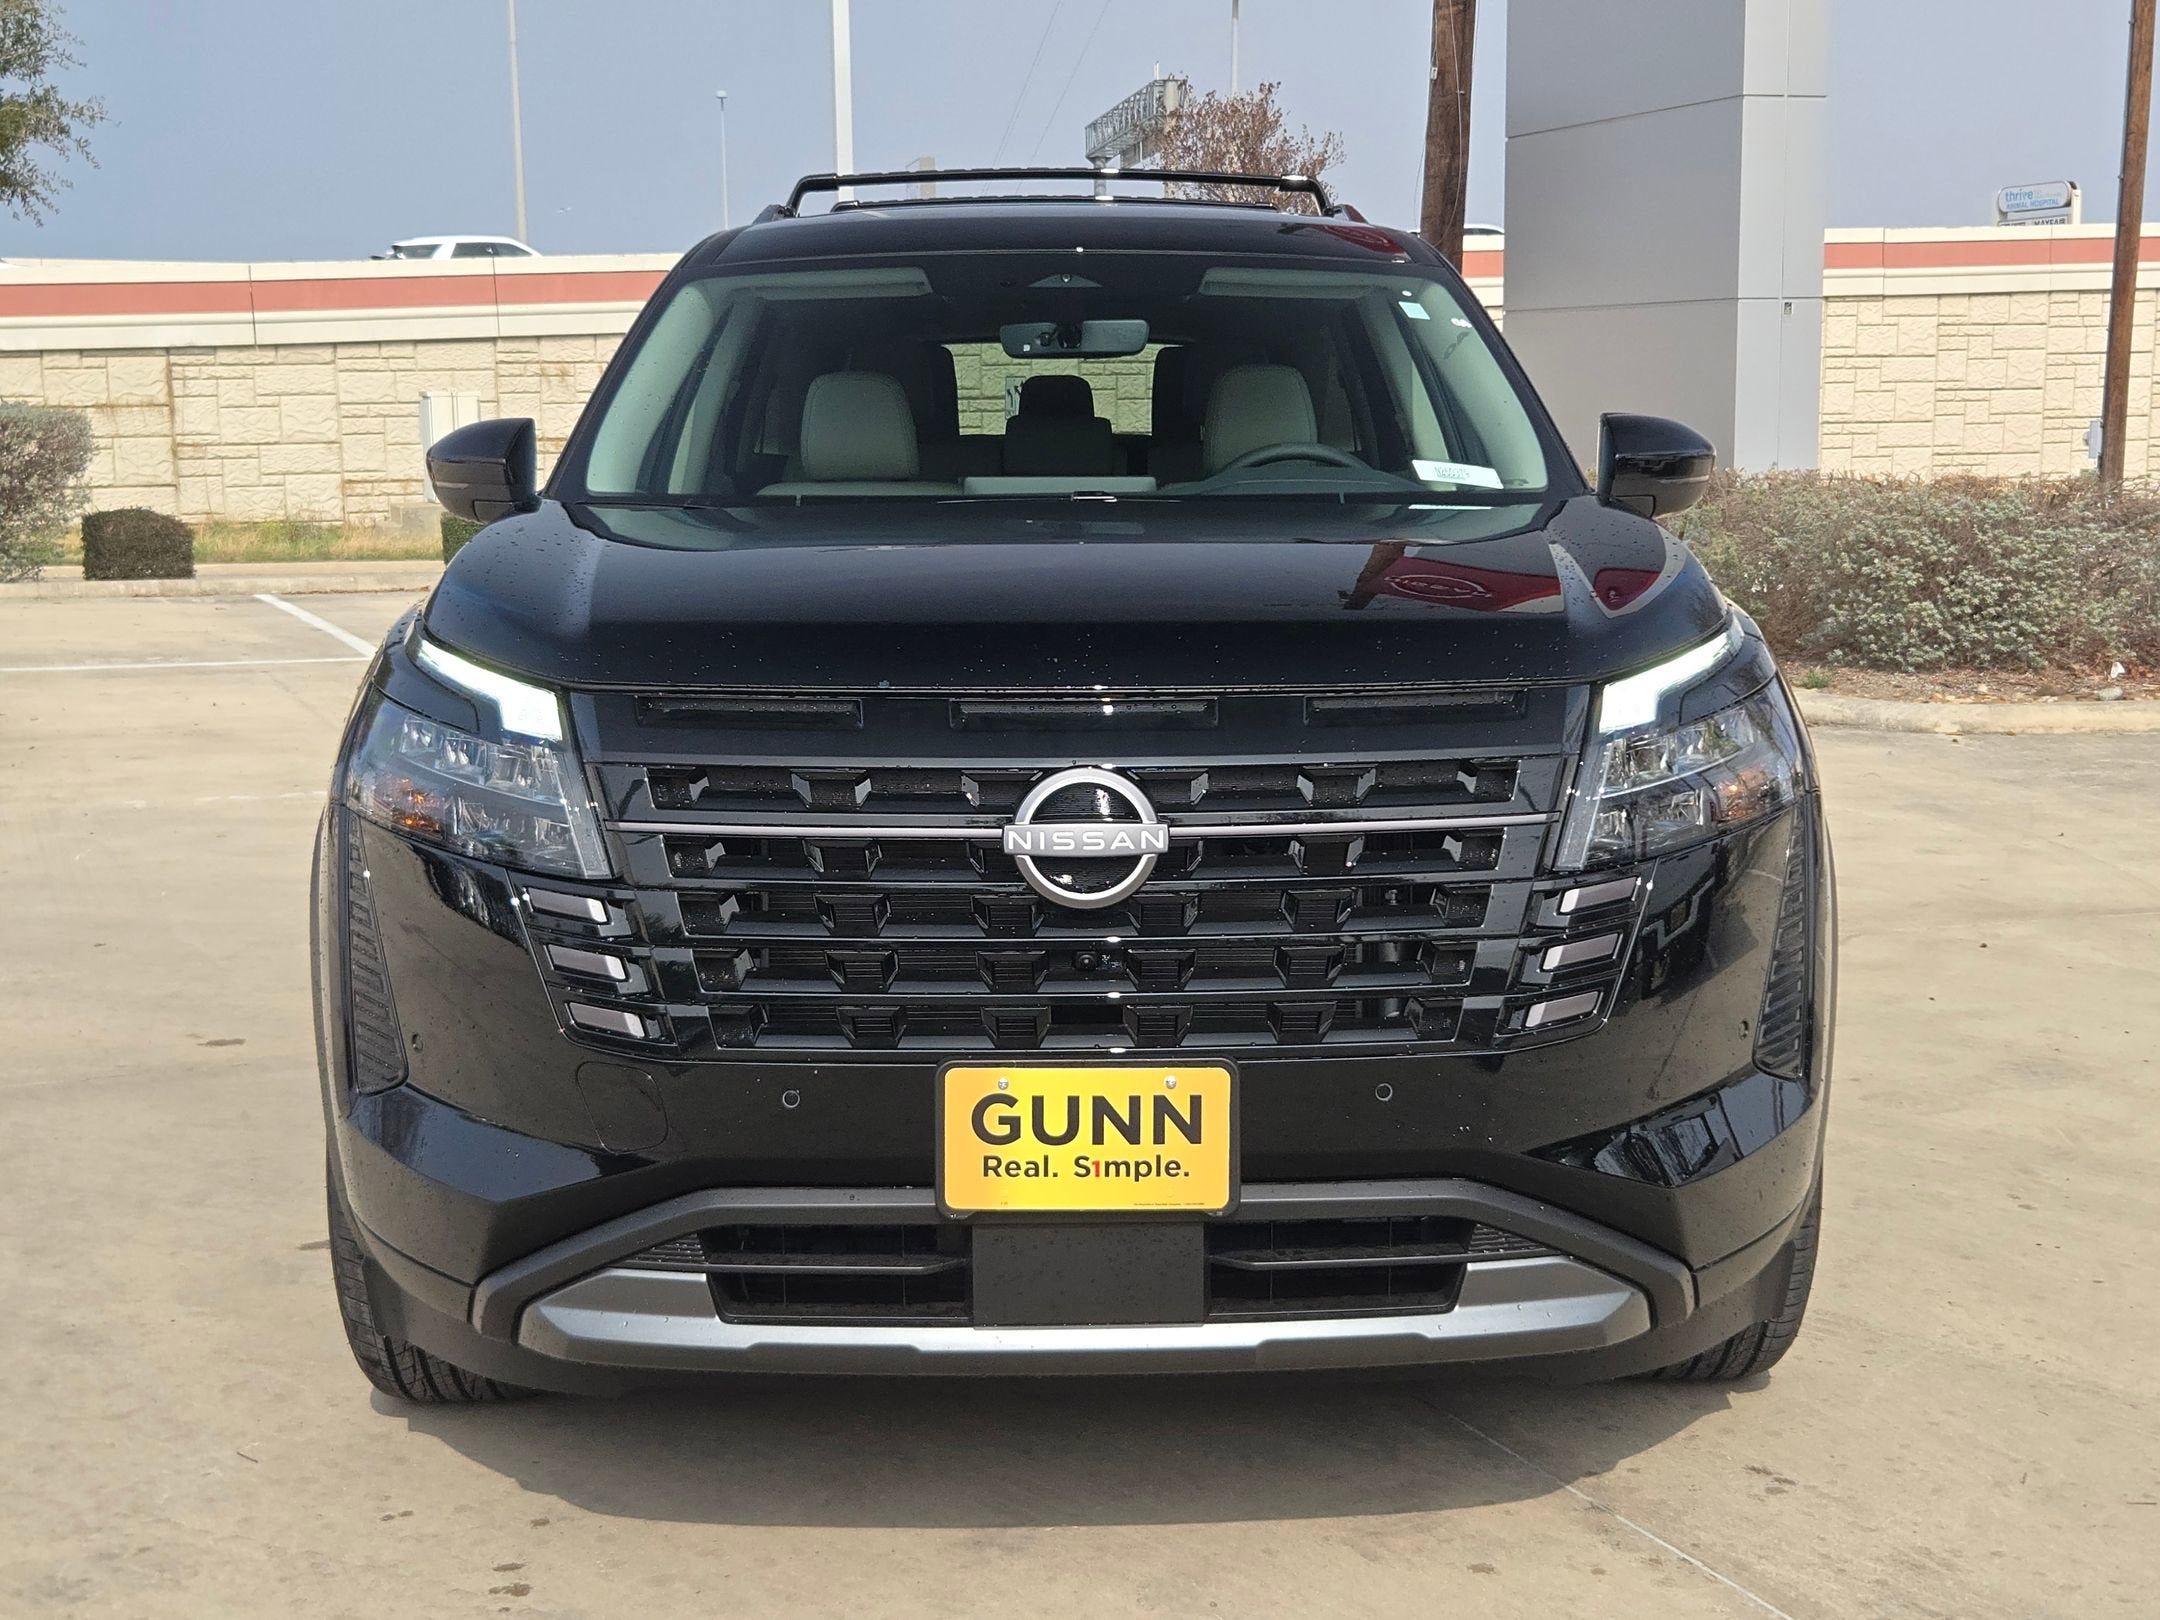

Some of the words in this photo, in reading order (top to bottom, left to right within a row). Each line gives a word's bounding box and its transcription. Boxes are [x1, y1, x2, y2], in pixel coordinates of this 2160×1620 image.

[2005, 189, 2033, 202] thrive
[2030, 199, 2059, 207] HOSPITAL
[1008, 830, 1164, 851] NISSAN
[971, 1092, 1202, 1146] GUNN
[982, 1154, 1059, 1178] Real.
